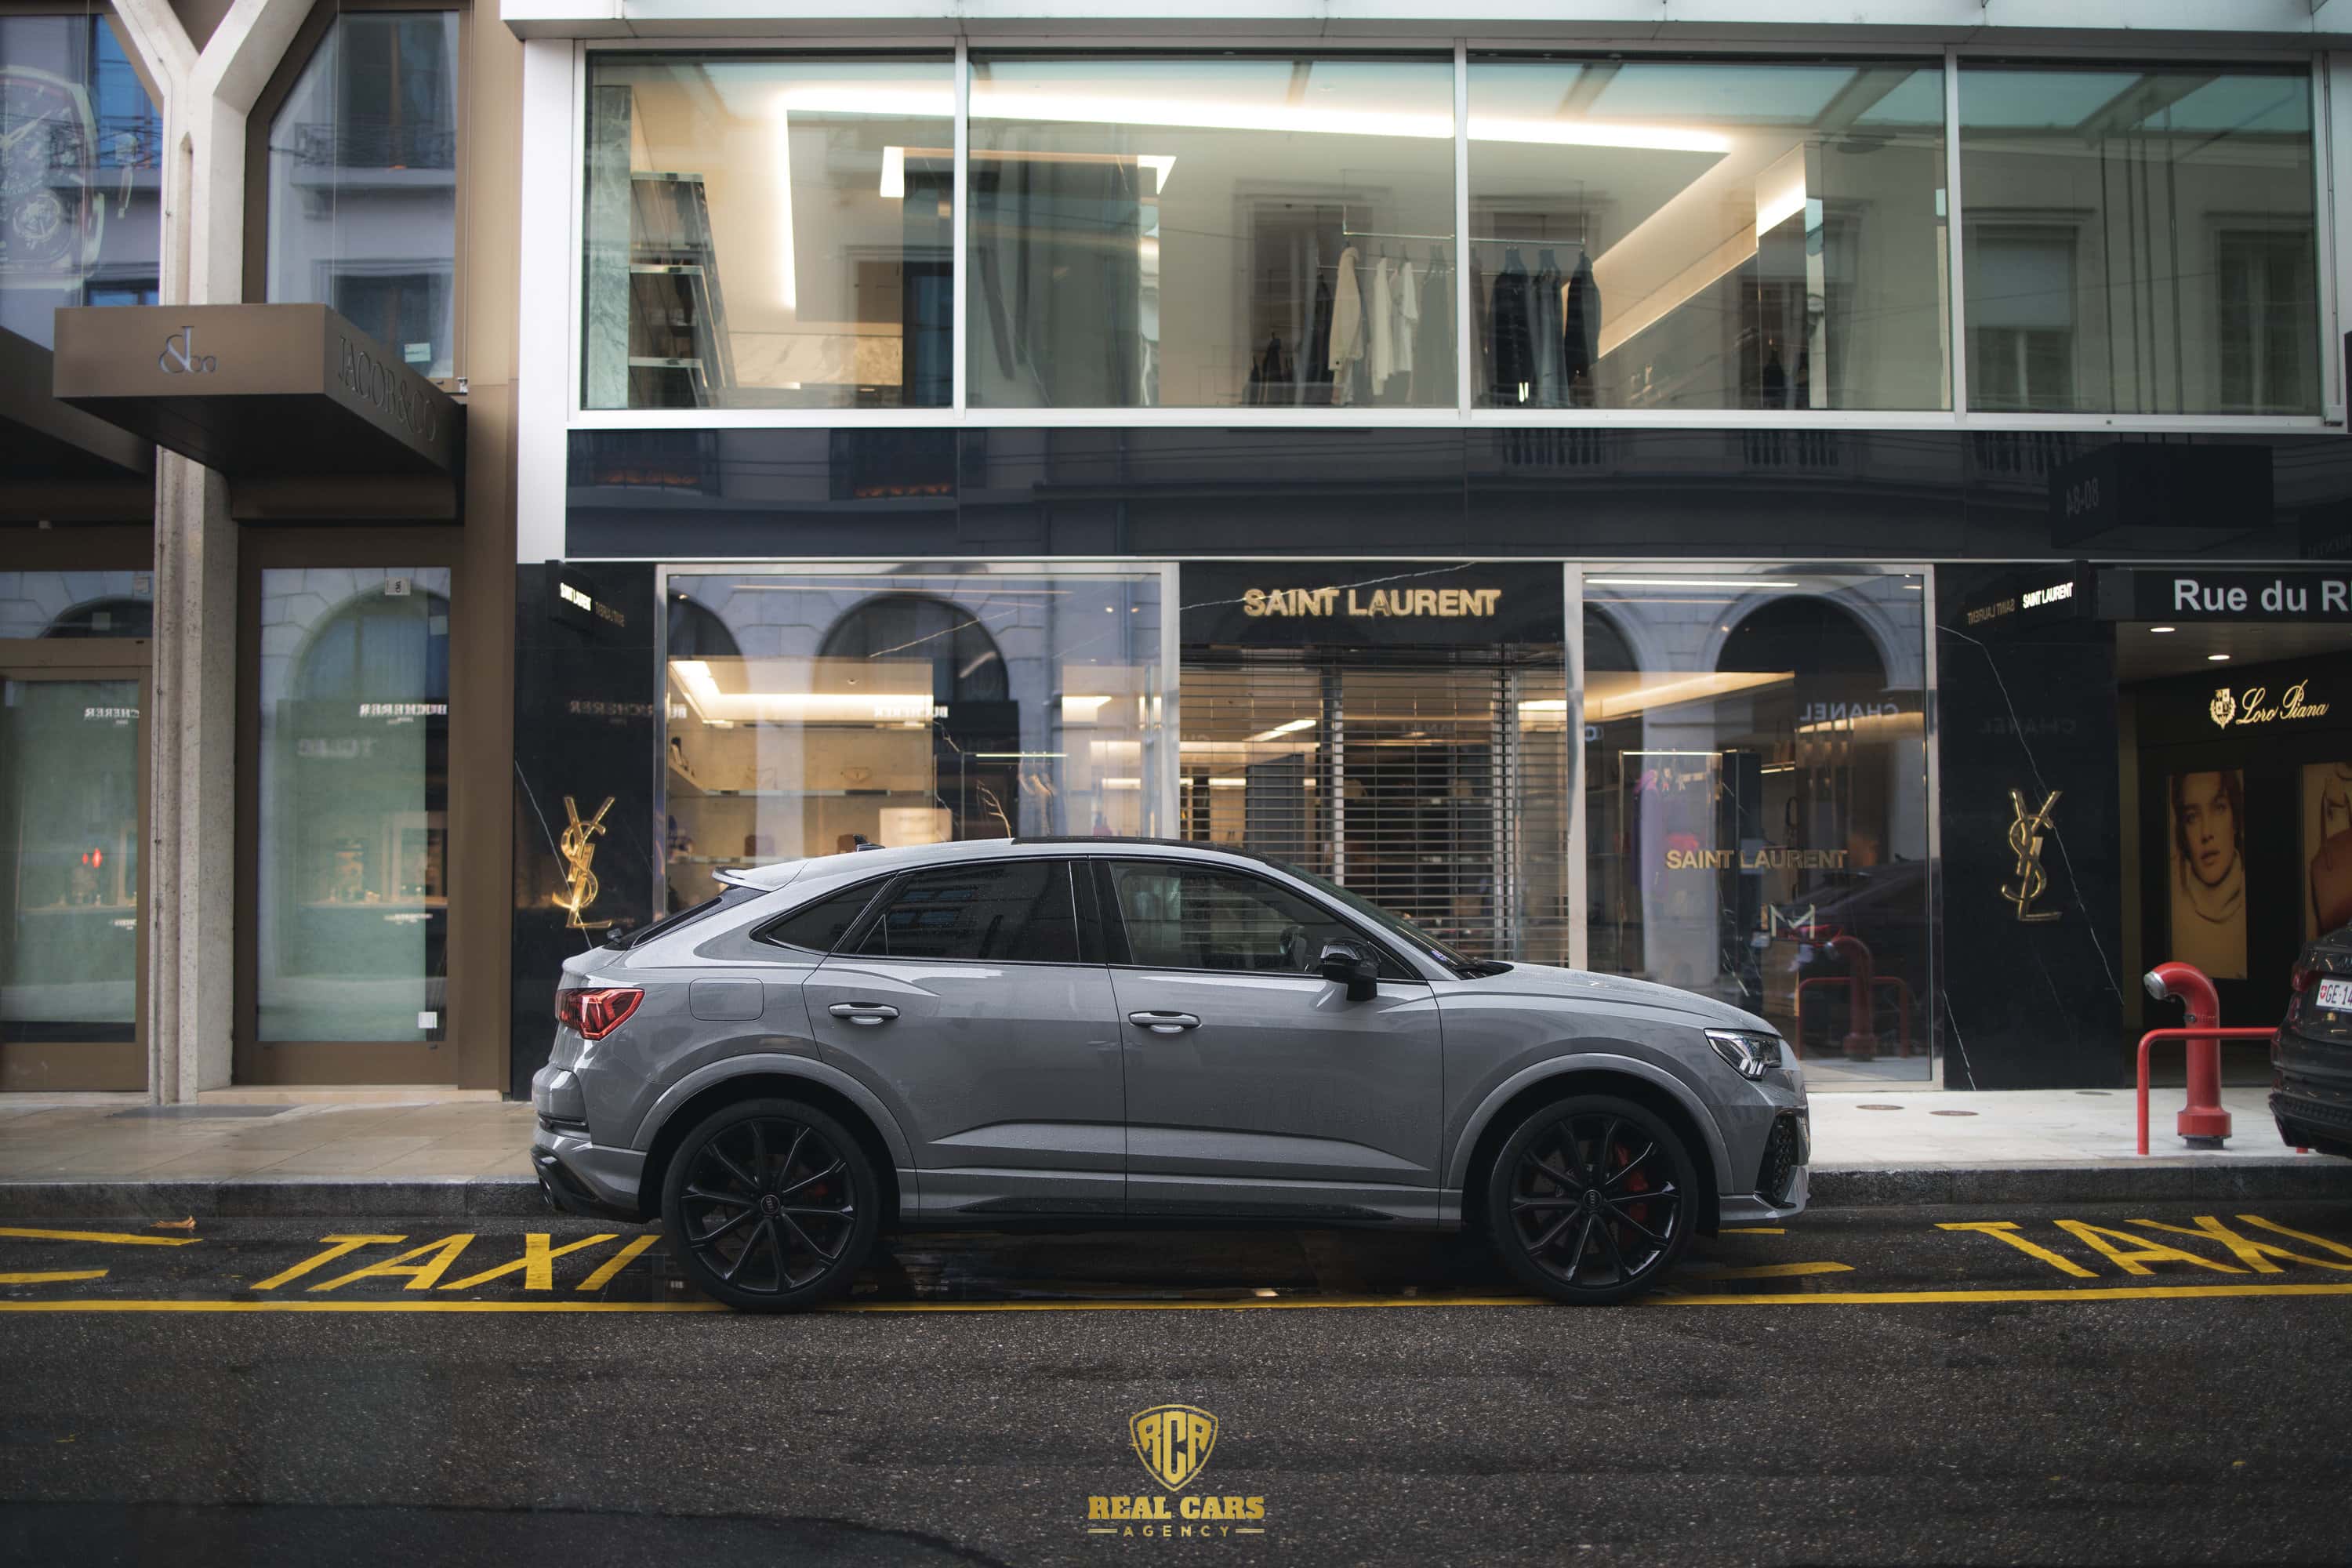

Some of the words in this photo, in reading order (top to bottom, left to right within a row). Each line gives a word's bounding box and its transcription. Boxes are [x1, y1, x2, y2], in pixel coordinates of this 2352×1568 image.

[1243, 588, 1340, 617] SAINT
[1348, 588, 1503, 617] LAURENT
[2023, 590, 2042, 609] SAINT
[2042, 582, 2074, 604] LAURENT
[2174, 579, 2248, 612] Rue
[2260, 579, 2307, 612] du
[2321, 579, 2352, 612] R
[2235, 687, 2279, 725] Loro
[2279, 678, 2331, 720] Piana
[1666, 849, 1735, 869] SAINT
[1740, 849, 1849, 869] LAURENT
[249, 1233, 662, 1291] TAXI
